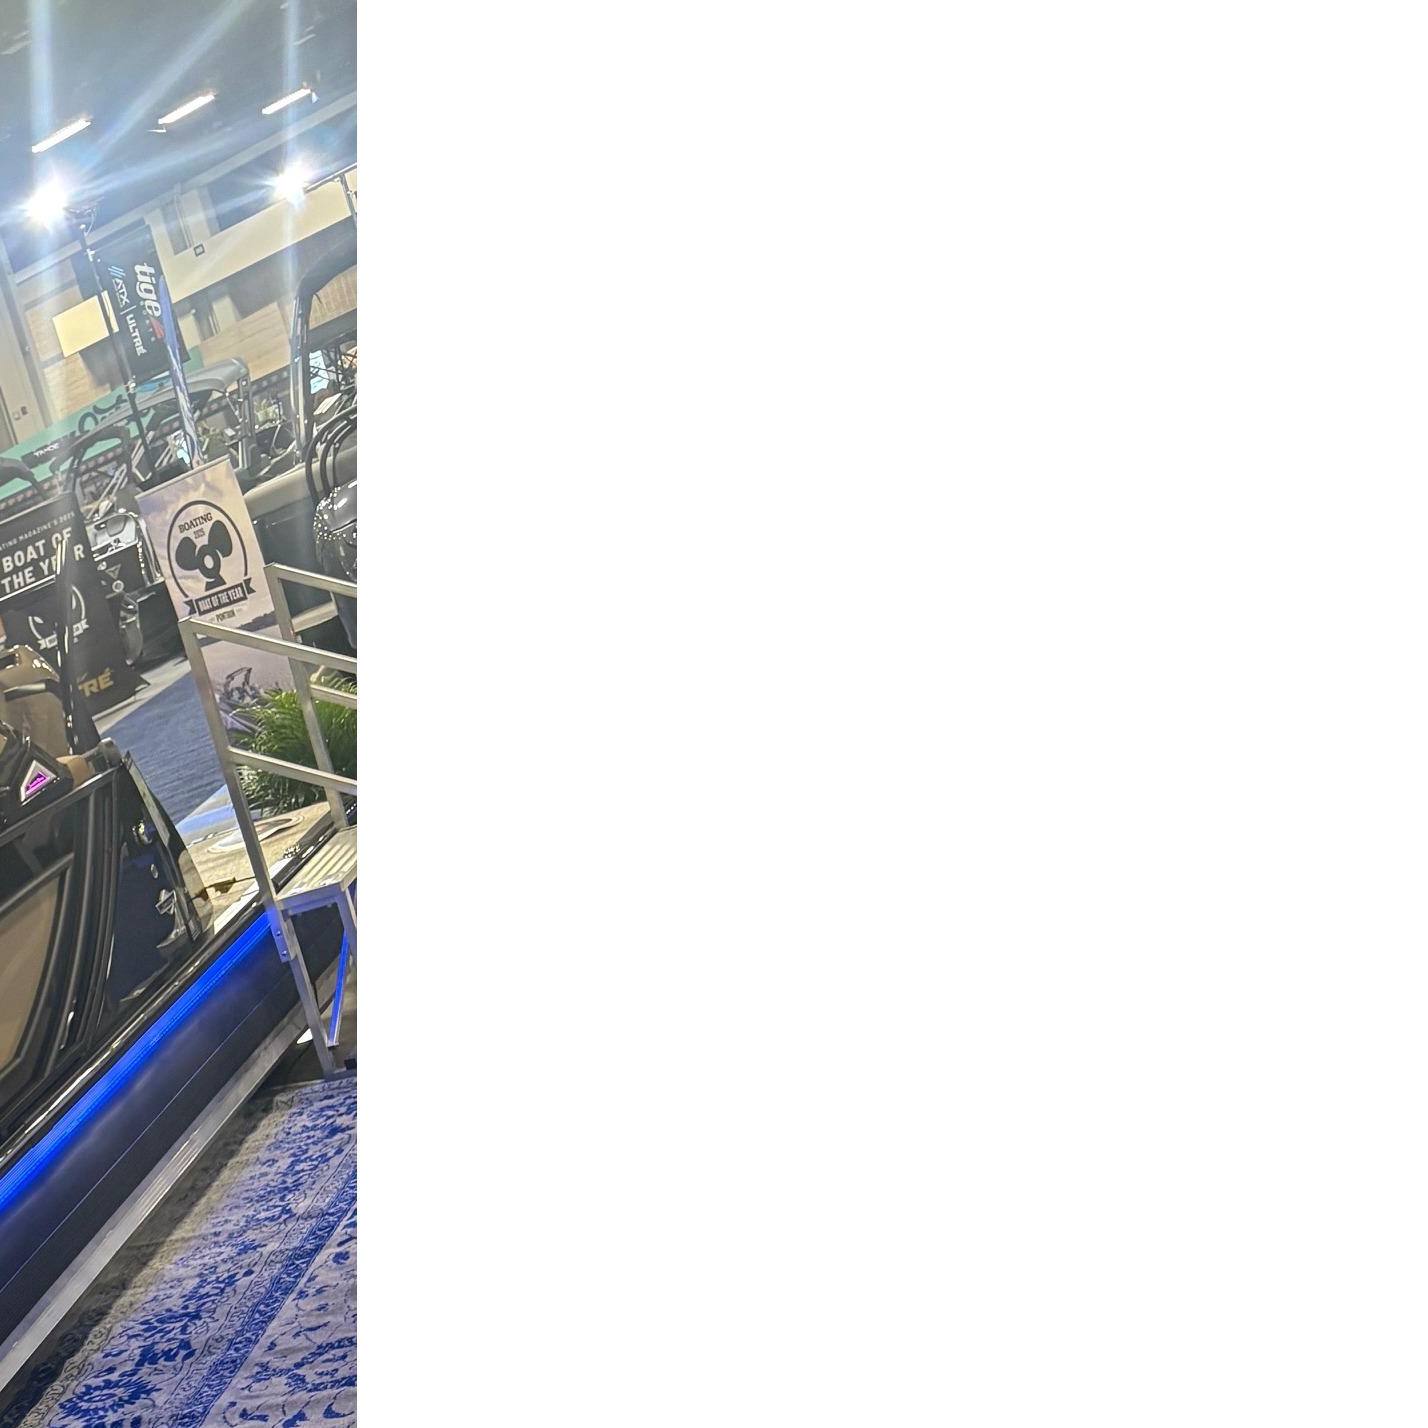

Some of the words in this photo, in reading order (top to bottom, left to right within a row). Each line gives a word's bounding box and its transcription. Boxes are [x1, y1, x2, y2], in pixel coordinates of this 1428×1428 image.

[178, 512, 213, 533] BOATING
[1, 540, 46, 573] BOAT
[51, 527, 72, 550] OF
[0, 566, 36, 594] THE
[228, 587, 243, 601] YEAR
